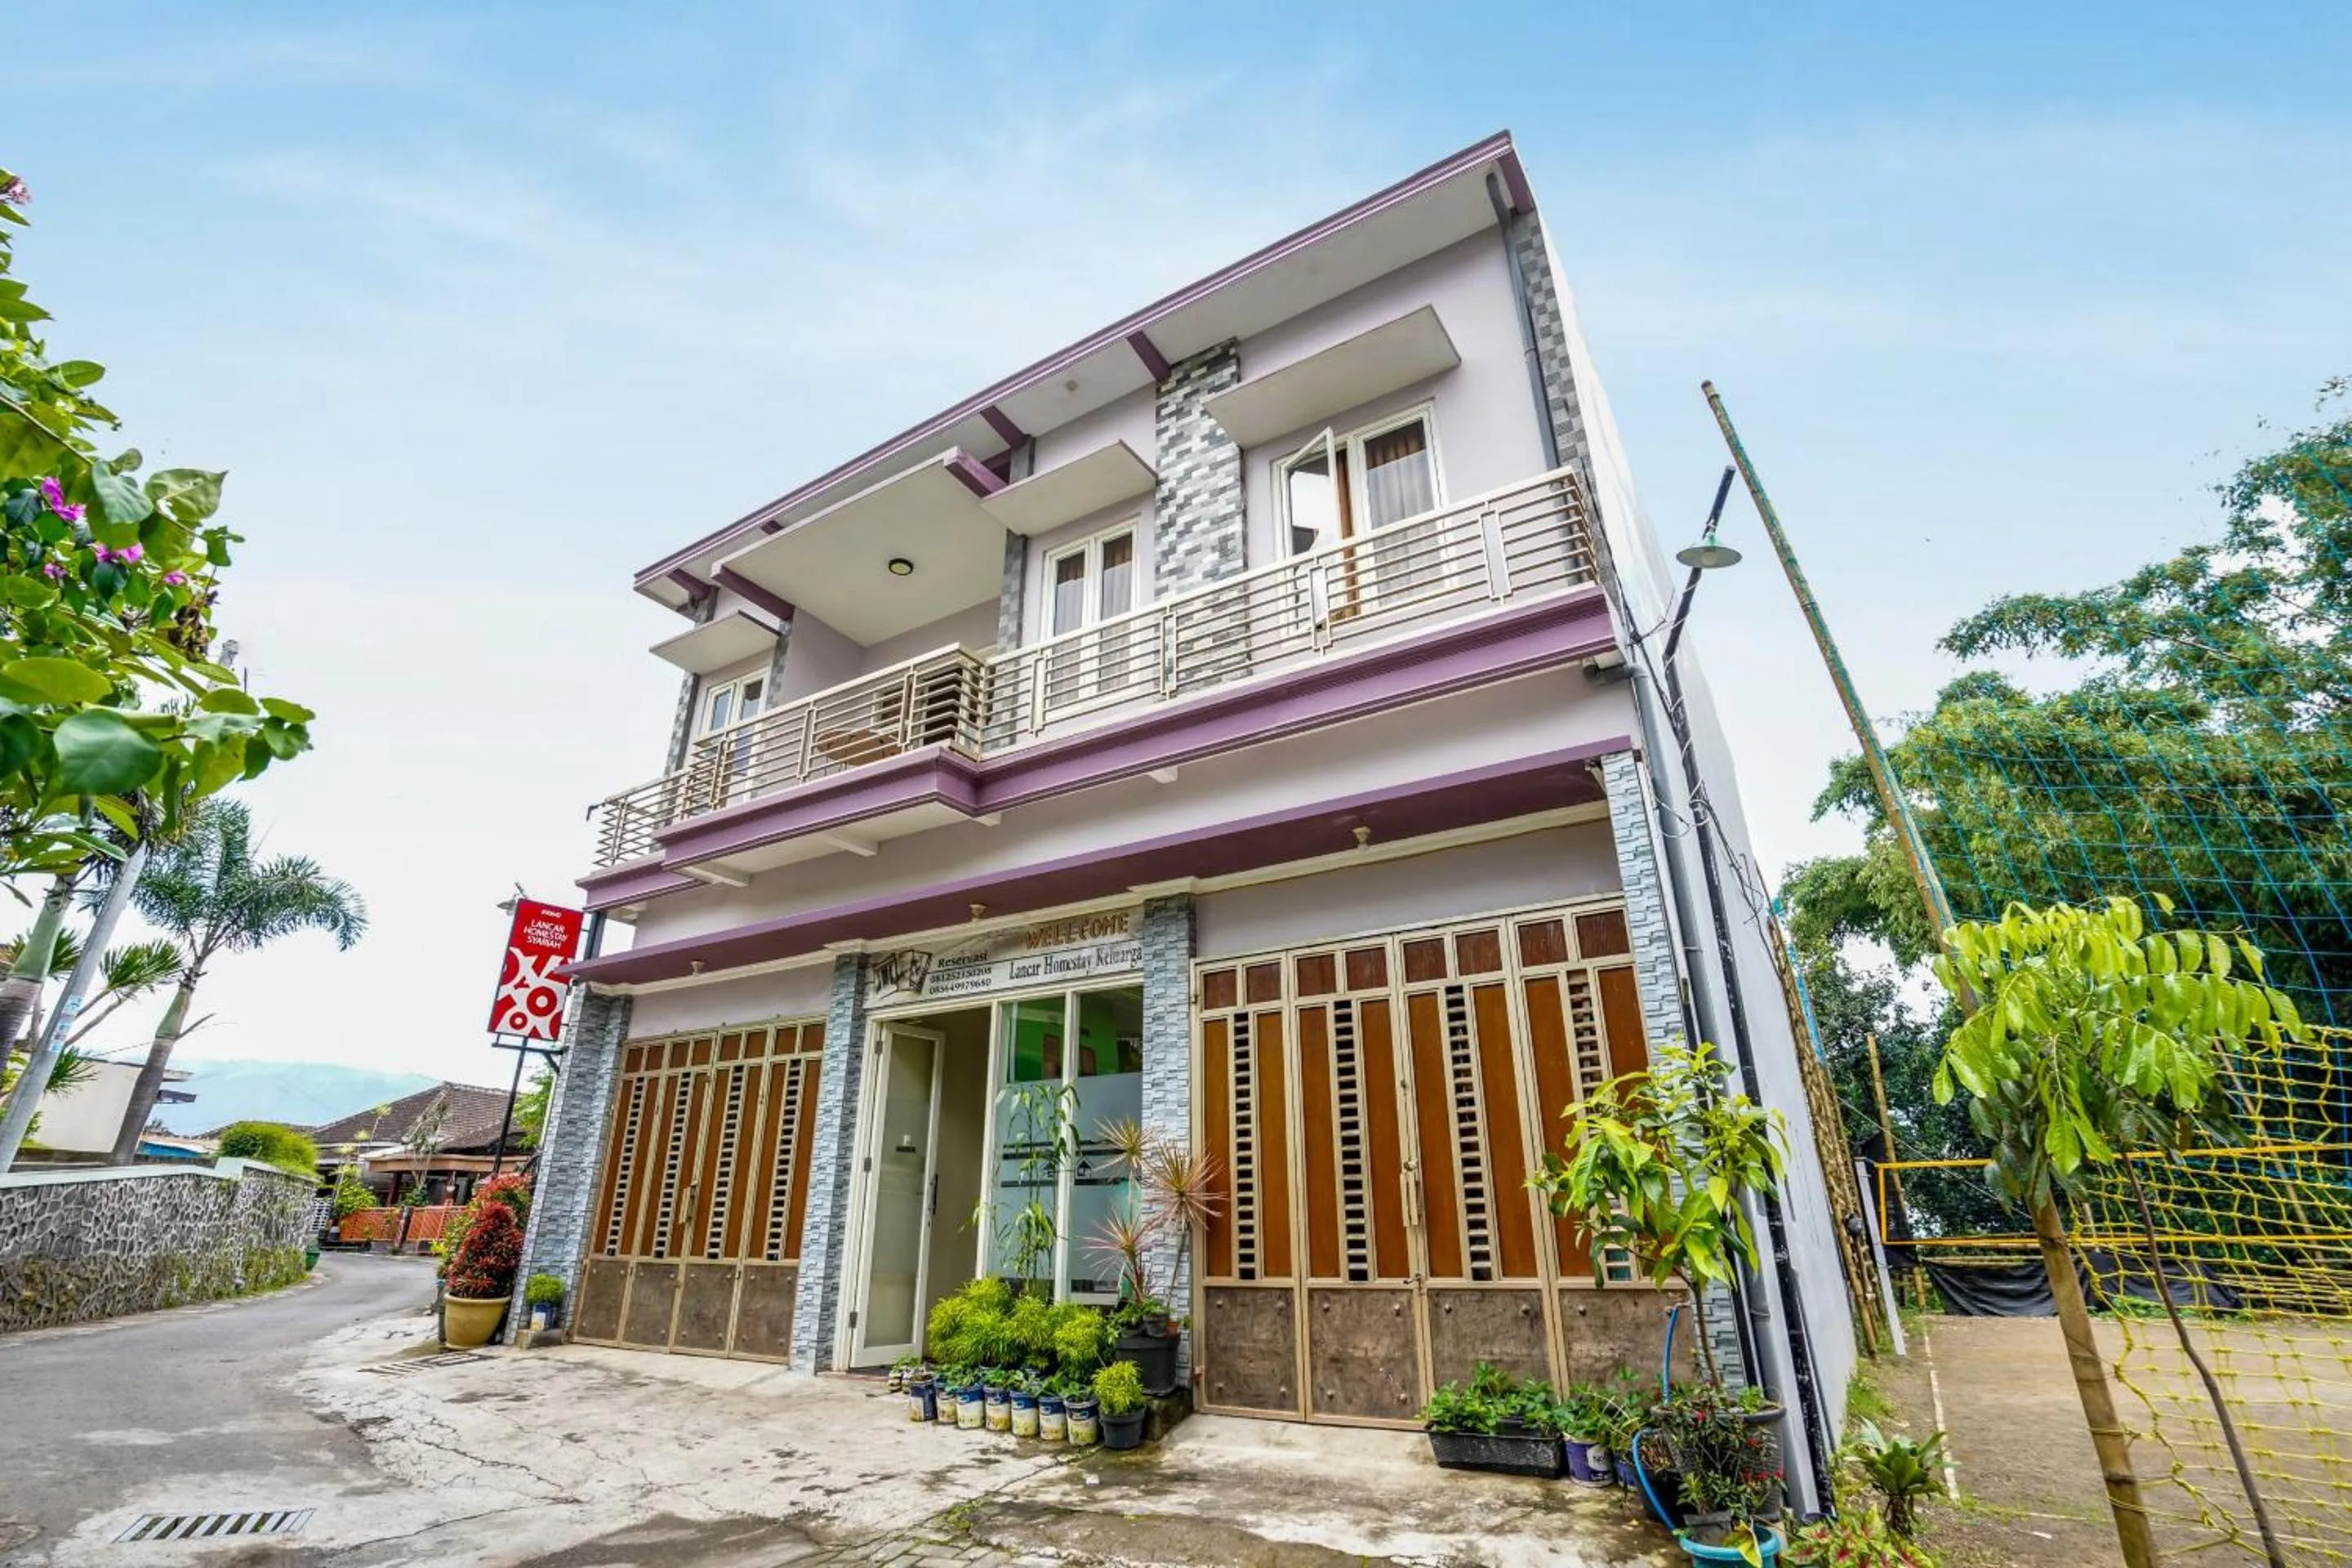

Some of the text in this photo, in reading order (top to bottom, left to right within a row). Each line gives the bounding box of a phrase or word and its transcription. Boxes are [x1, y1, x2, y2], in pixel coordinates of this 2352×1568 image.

[523, 925, 568, 942] HOMESTAY
[531, 919, 565, 933] LANCAR
[526, 935, 562, 949] SYARIAH
[938, 951, 988, 968] Reservasi
[1044, 953, 1092, 975] Homestay
